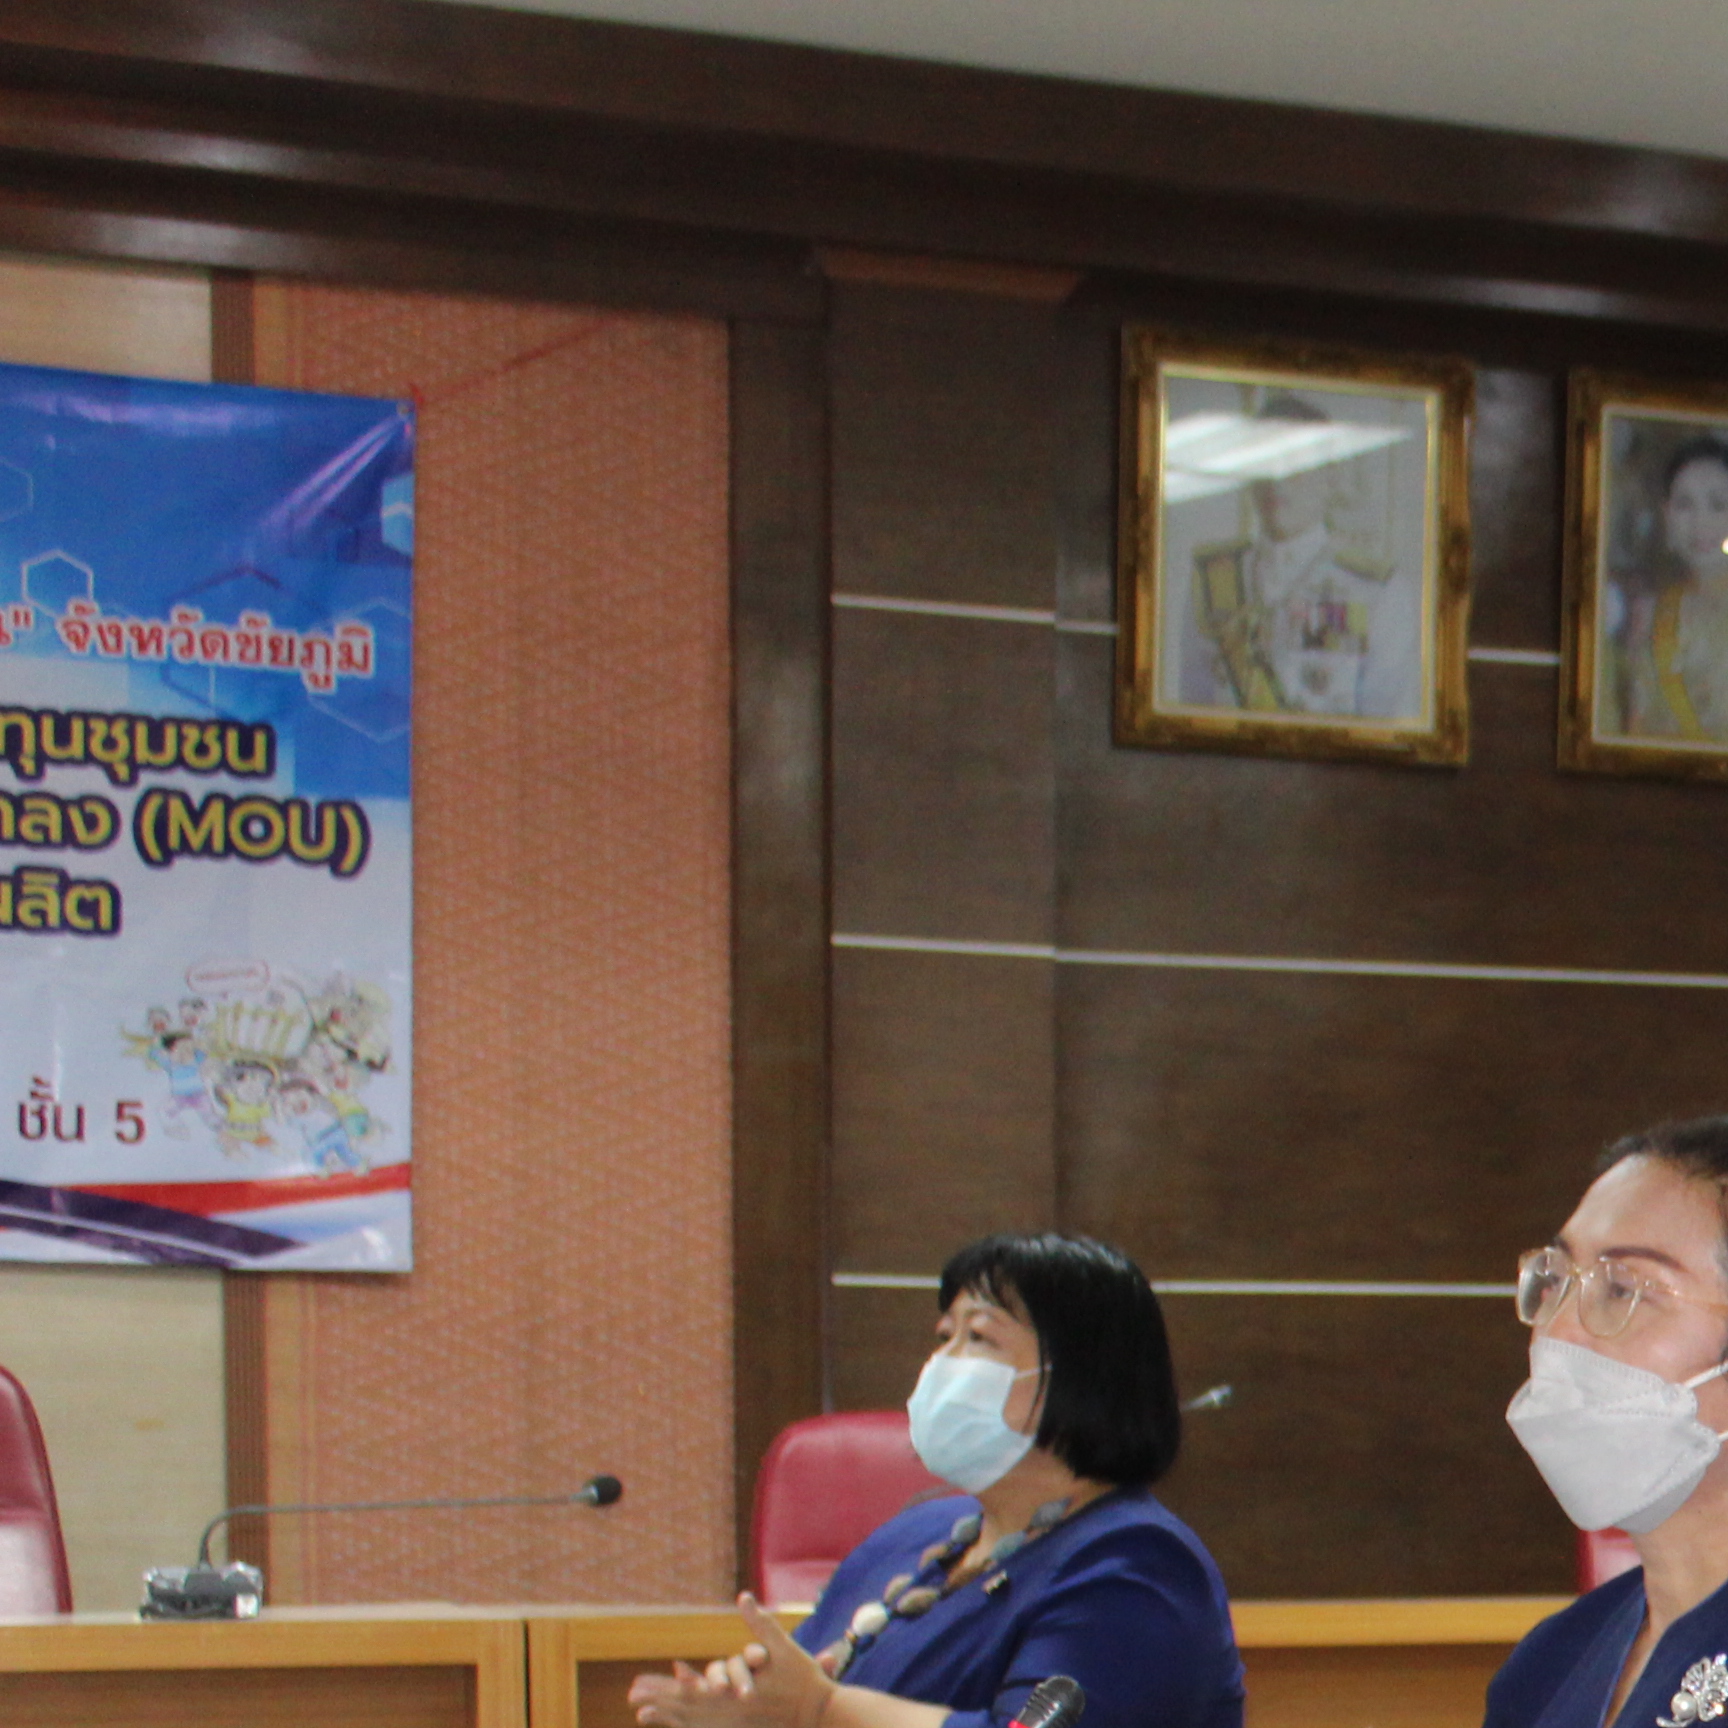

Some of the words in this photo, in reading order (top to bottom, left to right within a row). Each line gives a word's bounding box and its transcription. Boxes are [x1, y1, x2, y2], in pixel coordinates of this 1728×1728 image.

[138, 789, 366, 876] (MOU)
[18, 1075, 86, 1142] ชั้น
[115, 1099, 147, 1144] 5
